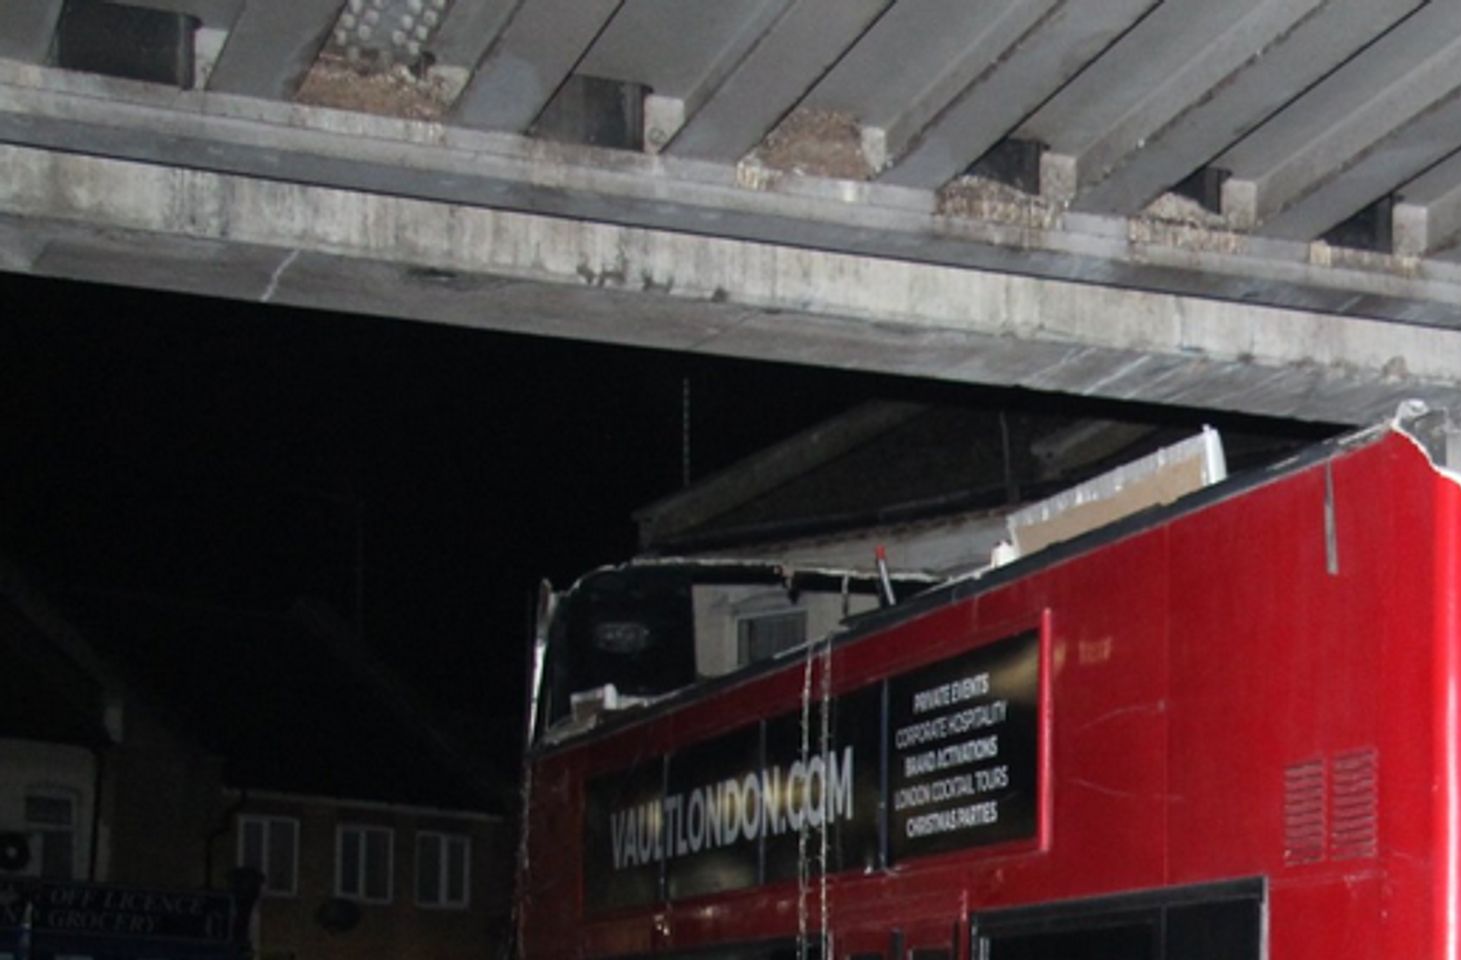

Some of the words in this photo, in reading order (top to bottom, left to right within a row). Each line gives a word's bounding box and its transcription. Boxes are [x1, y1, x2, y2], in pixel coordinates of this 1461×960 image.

[914, 684, 950, 714] PRIVATE
[951, 673, 989, 703] EVENTS
[896, 717, 948, 749] CORPORATE
[950, 701, 1007, 733] HOSPITALITY
[905, 751, 936, 777] BRAND
[937, 735, 998, 768] ACTIVATIONS
[610, 746, 853, 869] VAULTLONDON.COM
[895, 785, 930, 810] LONDON
[932, 774, 975, 801] COCKTAIL
[975, 765, 1009, 792] TOURS
[906, 810, 956, 838] CHRISTMAS
[956, 801, 998, 827] PARTIES
